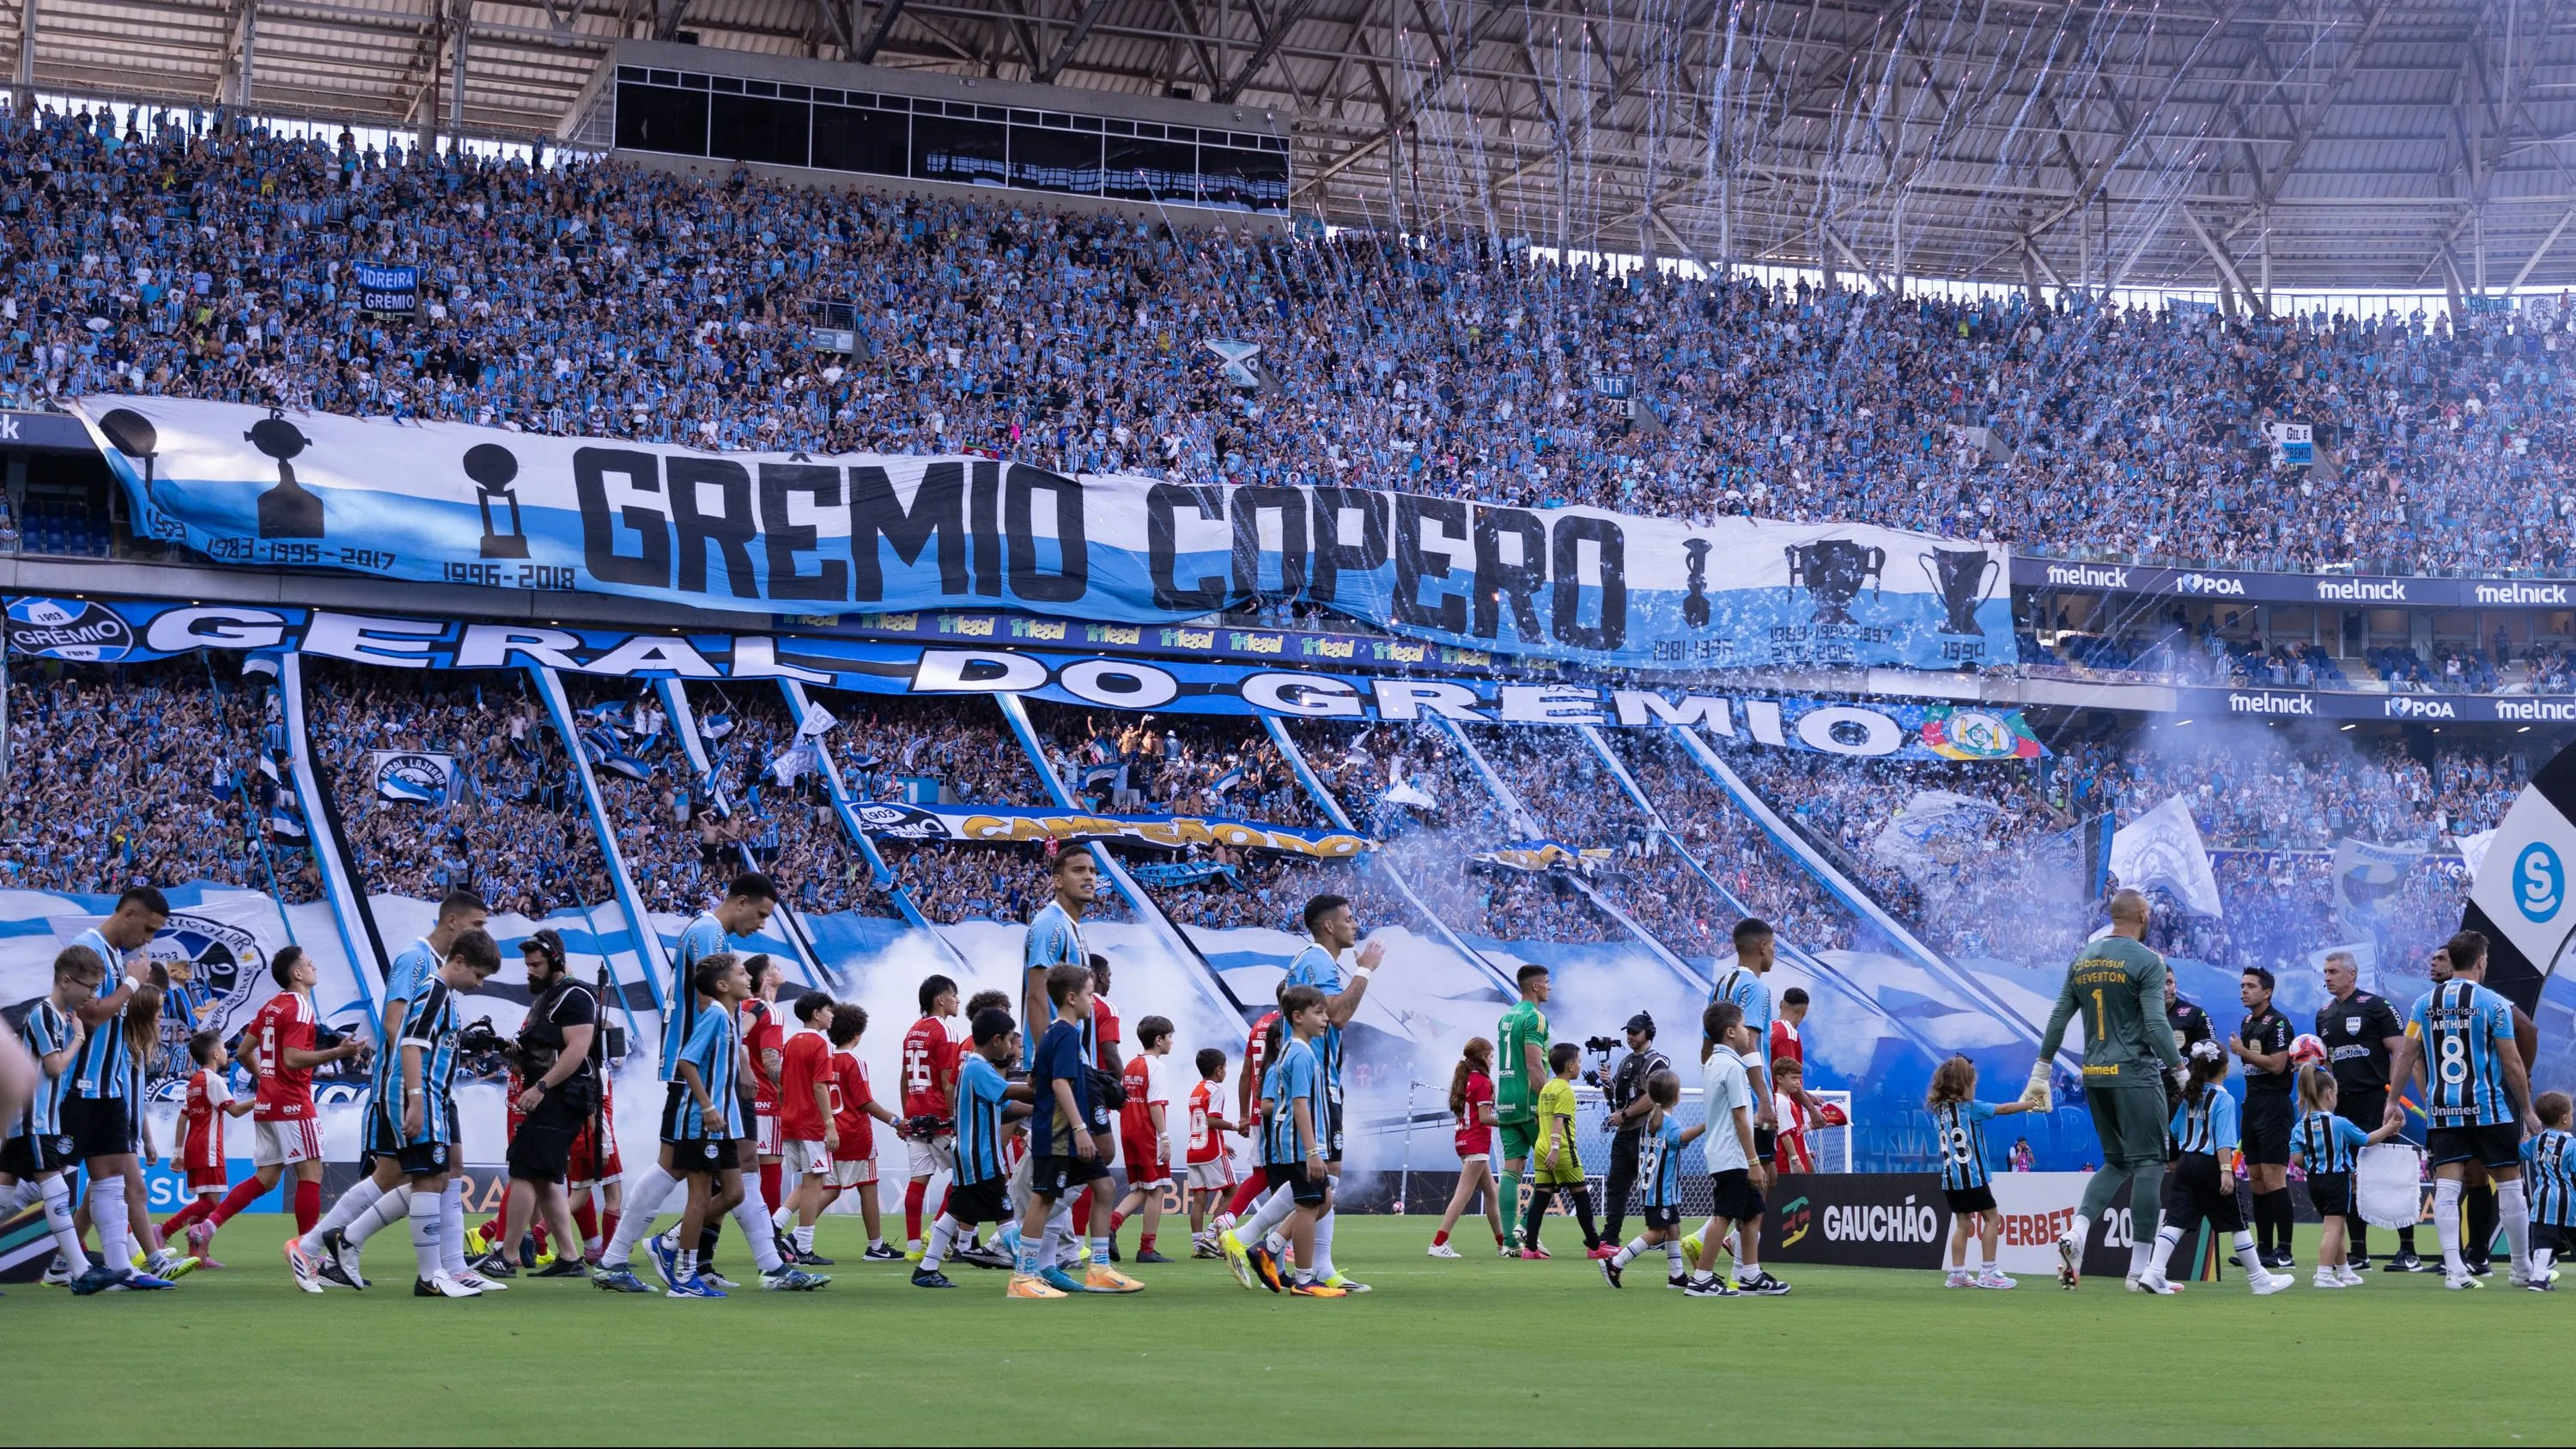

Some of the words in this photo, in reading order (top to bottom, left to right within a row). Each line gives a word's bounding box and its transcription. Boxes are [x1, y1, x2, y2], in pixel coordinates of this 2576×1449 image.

[365, 291, 416, 310] GRÊMIO
[574, 447, 1089, 603] GRÊMIO
[1147, 484, 1625, 651] COPERO
[2047, 564, 2128, 588] melnick
[2203, 578, 2245, 594] POA
[2318, 578, 2405, 600] melnick
[2476, 582, 2567, 604] melnick
[37, 612, 63, 622] 1903
[14, 620, 120, 645] GRÊMIO
[147, 606, 835, 685] GERAL
[911, 648, 1177, 709] DO
[1242, 673, 1901, 756] GRÊMIO
[2229, 691, 2312, 715] melnick
[2412, 701, 2456, 718] POA
[2495, 699, 2576, 720] melnic
[864, 809, 896, 820] 1903
[167, 916, 252, 953] RICOLOR
[715, 928, 726, 953] AVAN
[2084, 959, 2126, 970] banrisul
[2074, 971, 2126, 986] WEVERTON
[2091, 989, 2105, 1041] 1
[2436, 1007, 2480, 1017] banrisul
[2433, 1019, 2470, 1031] ARTHUR
[1504, 1032, 1511, 1069] 1
[2440, 1035, 2468, 1085] 8
[2430, 1105, 2481, 1117] Unimed
